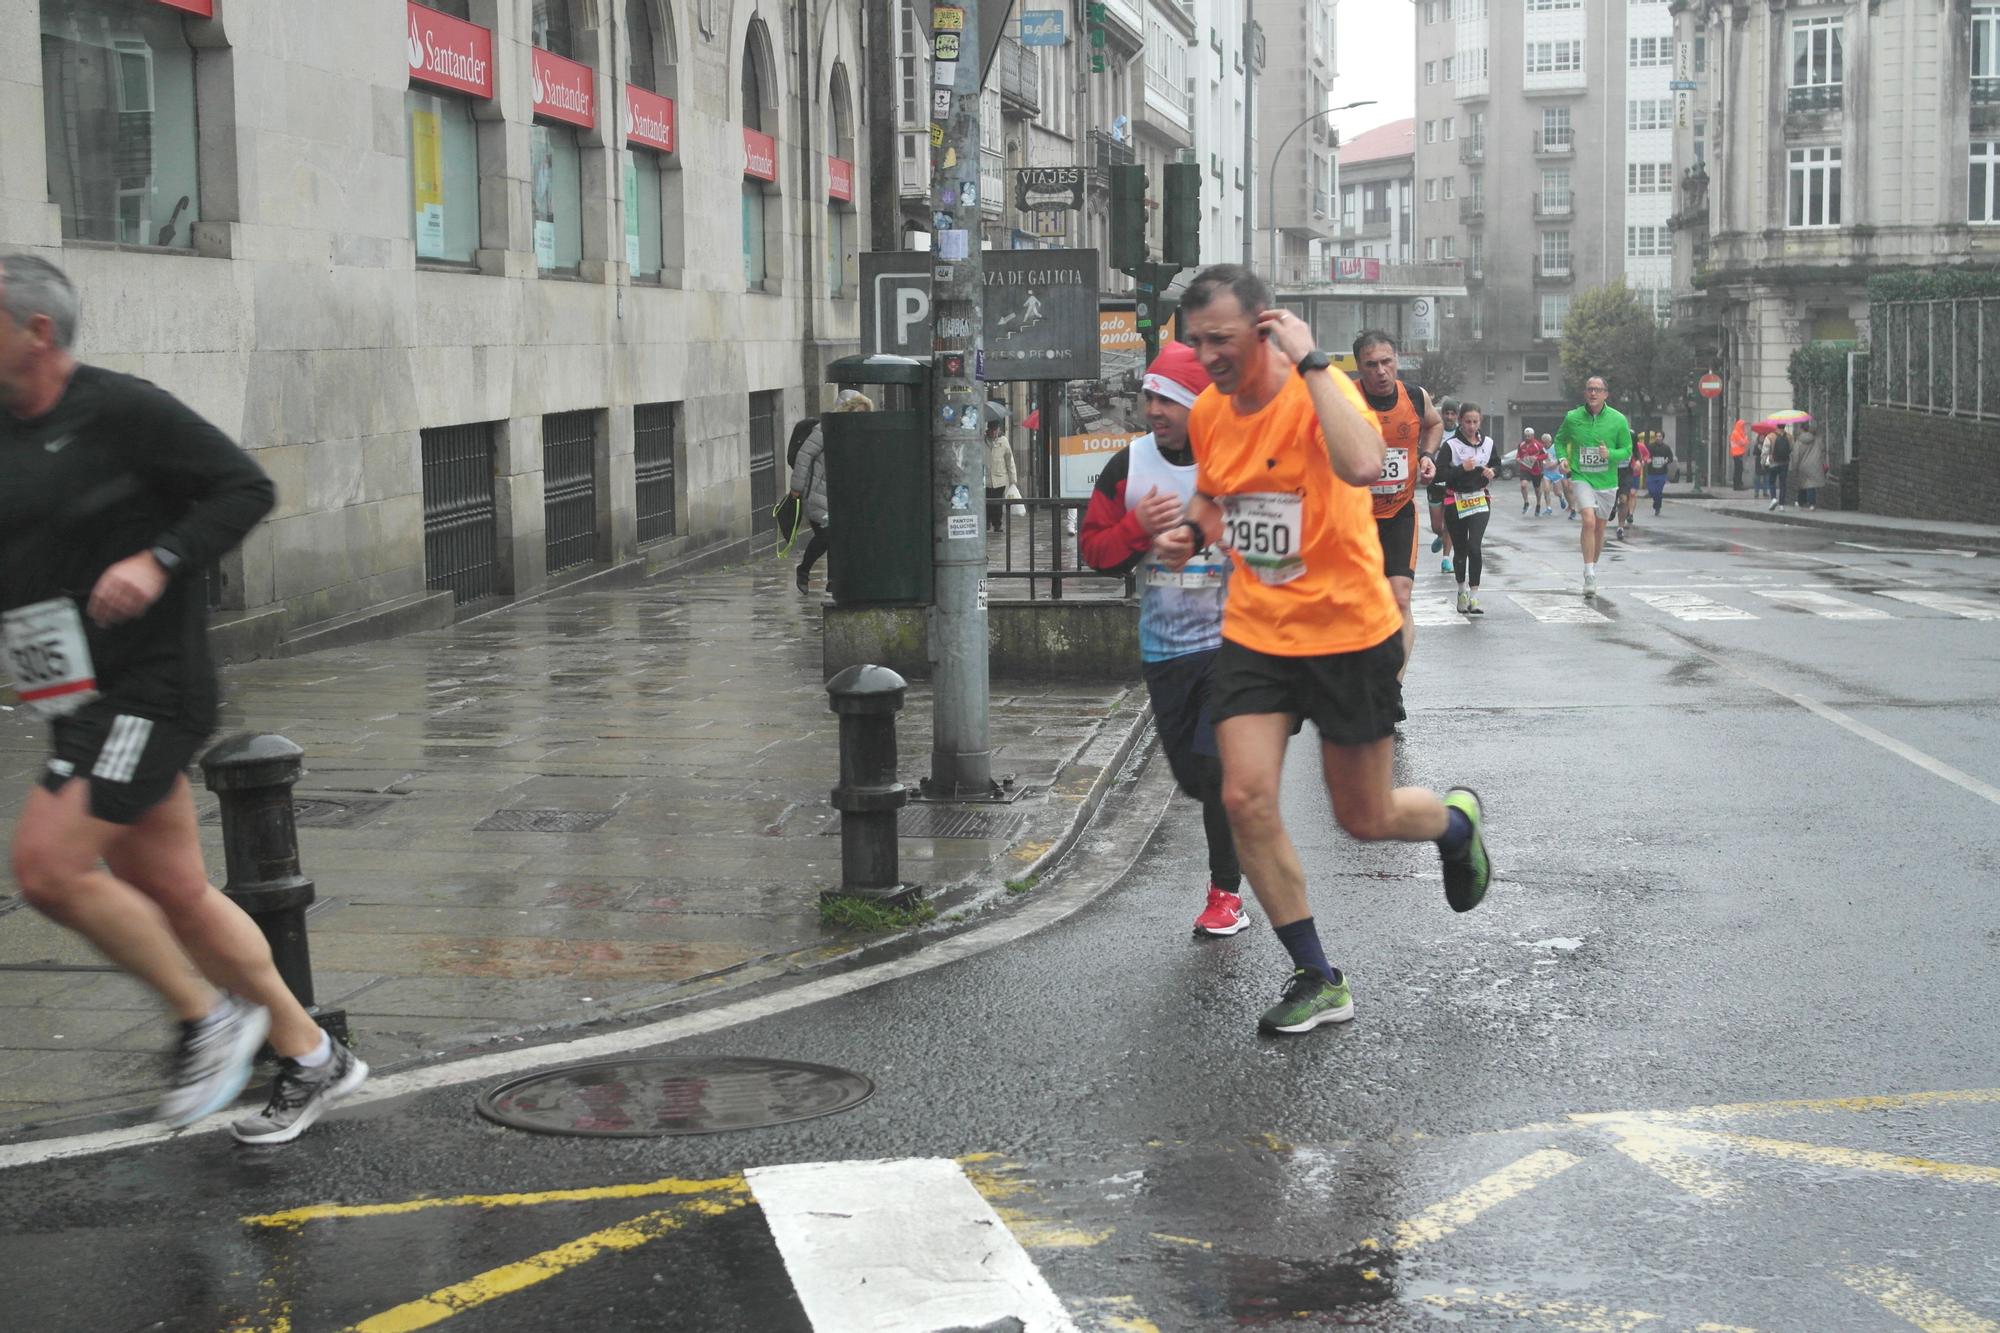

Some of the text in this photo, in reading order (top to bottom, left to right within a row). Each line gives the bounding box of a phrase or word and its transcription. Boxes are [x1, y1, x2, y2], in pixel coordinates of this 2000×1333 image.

[426, 30, 486, 86] Santander
[544, 69, 589, 117] Santander
[634, 104, 670, 145] Santander
[748, 143, 773, 176] Santander
[1022, 171, 1078, 184] VIAJES
[982, 269, 1082, 286] AZA DE GALICIA
[897, 288, 929, 345] P
[1100, 315, 1125, 330] ado
[1227, 520, 1289, 554] 1950
